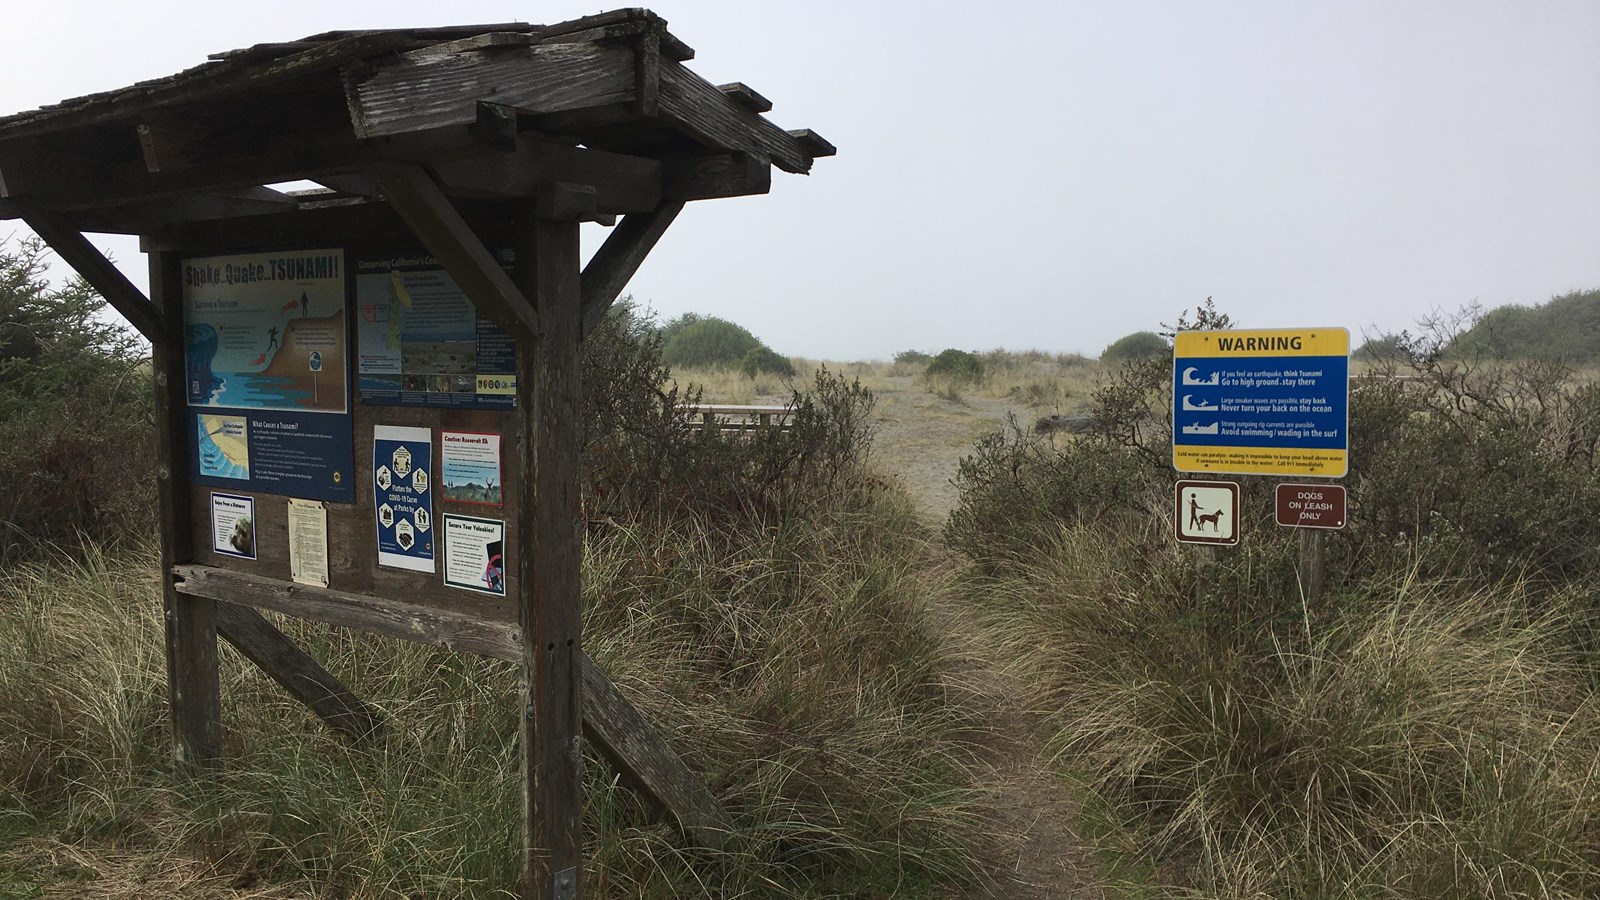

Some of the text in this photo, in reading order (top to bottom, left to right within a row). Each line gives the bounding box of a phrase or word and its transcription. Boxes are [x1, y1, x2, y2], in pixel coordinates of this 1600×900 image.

[270, 255, 338, 280] TSUNAMI!
[358, 260, 390, 270] Conserving
[391, 256, 424, 267] California's
[1218, 336, 1302, 351] WARNING
[1222, 378, 1230, 386] Go
[1240, 378, 1254, 388] high
[1282, 378, 1297, 388] stay
[1298, 378, 1316, 386] there
[1221, 397, 1234, 405] Large
[1300, 398, 1312, 406] stay
[1256, 406, 1272, 414] your
[1272, 404, 1288, 412] back
[252, 420, 263, 428] What
[263, 420, 276, 429] Causes
[280, 422, 299, 430] Tsunami?
[1221, 420, 1236, 430] Strong
[1311, 429, 1322, 437] the
[1324, 429, 1338, 437] surf
[392, 484, 405, 492] Flatten
[388, 494, 418, 504] COVID-19 Curve
[1297, 492, 1323, 500] DOGS
[409, 505, 414, 514] by
[1304, 502, 1333, 510] LEASH
[448, 521, 462, 529] Secure
[472, 524, 495, 534] Valuables!
